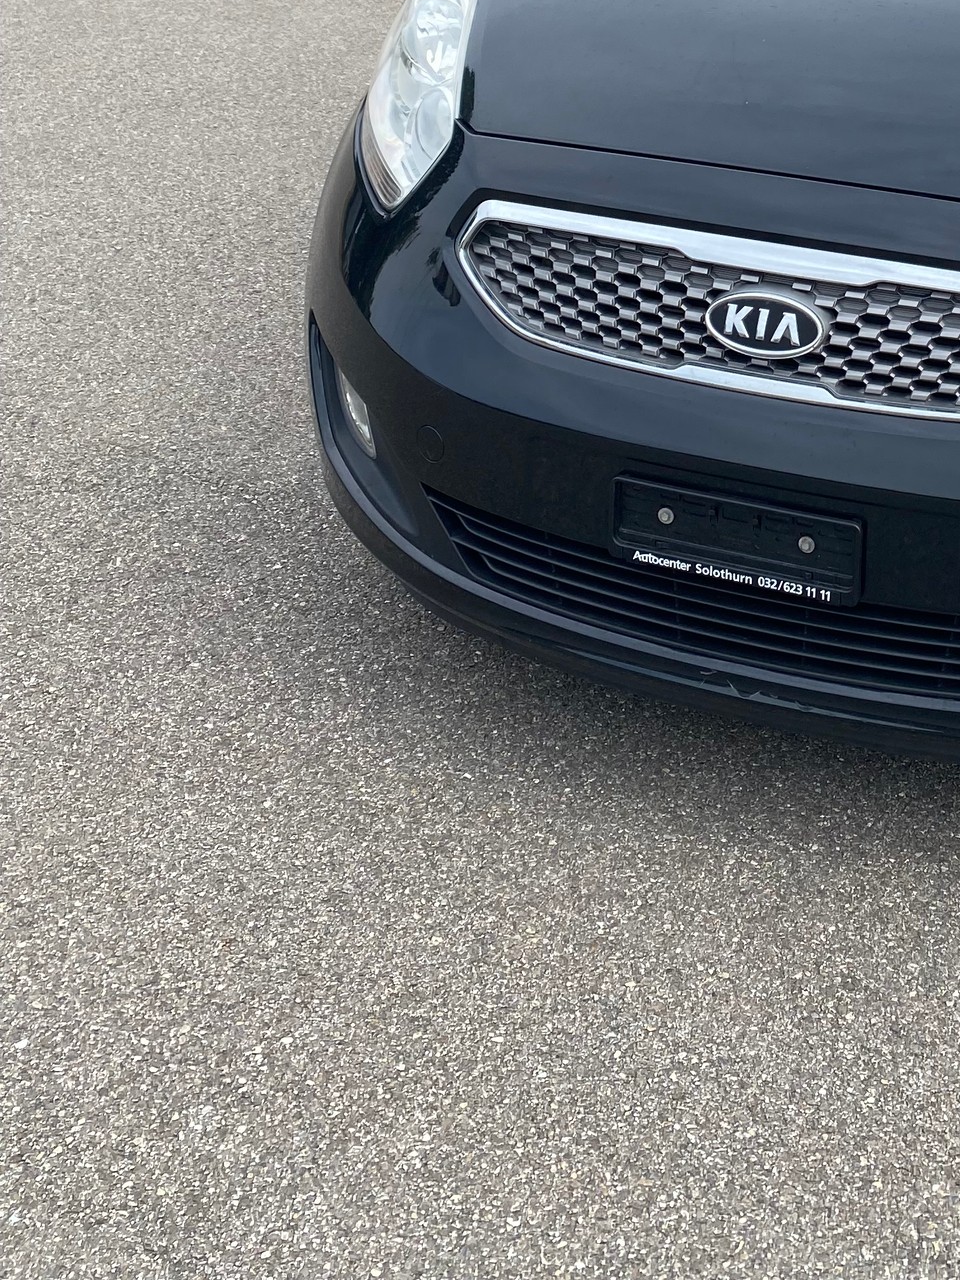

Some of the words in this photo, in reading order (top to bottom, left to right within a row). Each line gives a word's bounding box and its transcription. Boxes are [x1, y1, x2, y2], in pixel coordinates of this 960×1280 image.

[723, 303, 801, 347] KIA
[632, 550, 692, 572] Autocenter
[695, 563, 753, 585] Solothurn
[757, 576, 803, 595] 032/623
[805, 586, 816, 599] 11
[819, 590, 831, 602] 11
